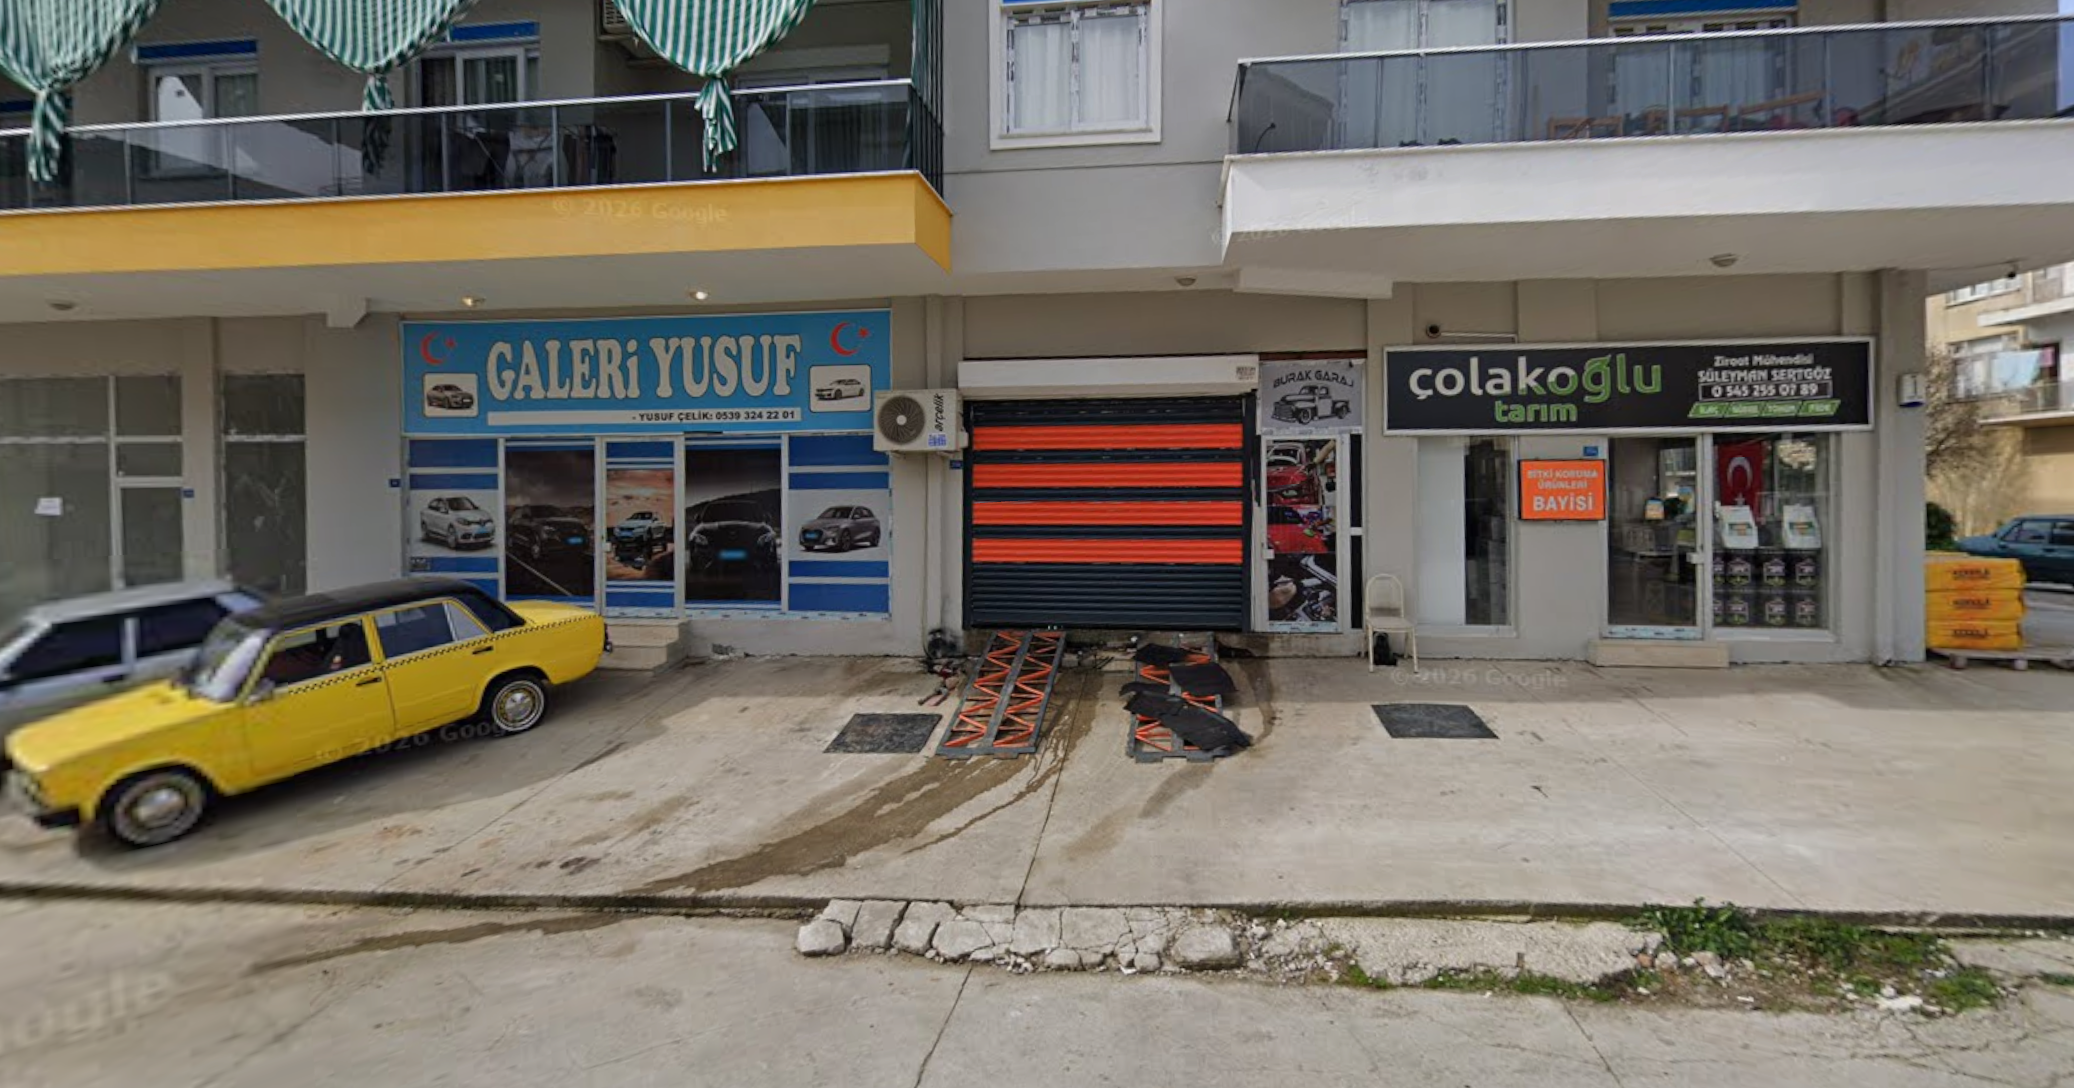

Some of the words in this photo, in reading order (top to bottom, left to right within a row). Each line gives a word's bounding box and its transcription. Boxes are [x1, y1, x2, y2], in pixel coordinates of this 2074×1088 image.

[649, 334, 802, 399] YUSUF
[1714, 355, 1750, 368] Ziraat
[1752, 353, 1815, 367] Mühendisi
[1273, 370, 1313, 389] BURAK
[1314, 370, 1354, 388] GARAJ
[1408, 353, 1663, 404] çolakoğlu
[1698, 367, 1768, 383] SÜLEYMAN
[1770, 366, 1833, 382] SERTGÖZ
[1711, 386, 1723, 398] 0
[1726, 384, 1749, 398] 545
[1752, 384, 1776, 397] 255
[1778, 383, 1798, 396] 07
[1800, 383, 1819, 396] 89
[639, 412, 676, 422] YUSUF
[678, 410, 713, 423] ÇELİK:
[715, 411, 741, 421] 0539
[743, 411, 765, 421] 324
[766, 411, 780, 420] 22
[782, 410, 796, 420] 01
[933, 392, 947, 432] arçelik
[1494, 399, 1578, 423] tarım
[1533, 492, 1594, 511] BAYİSİ
